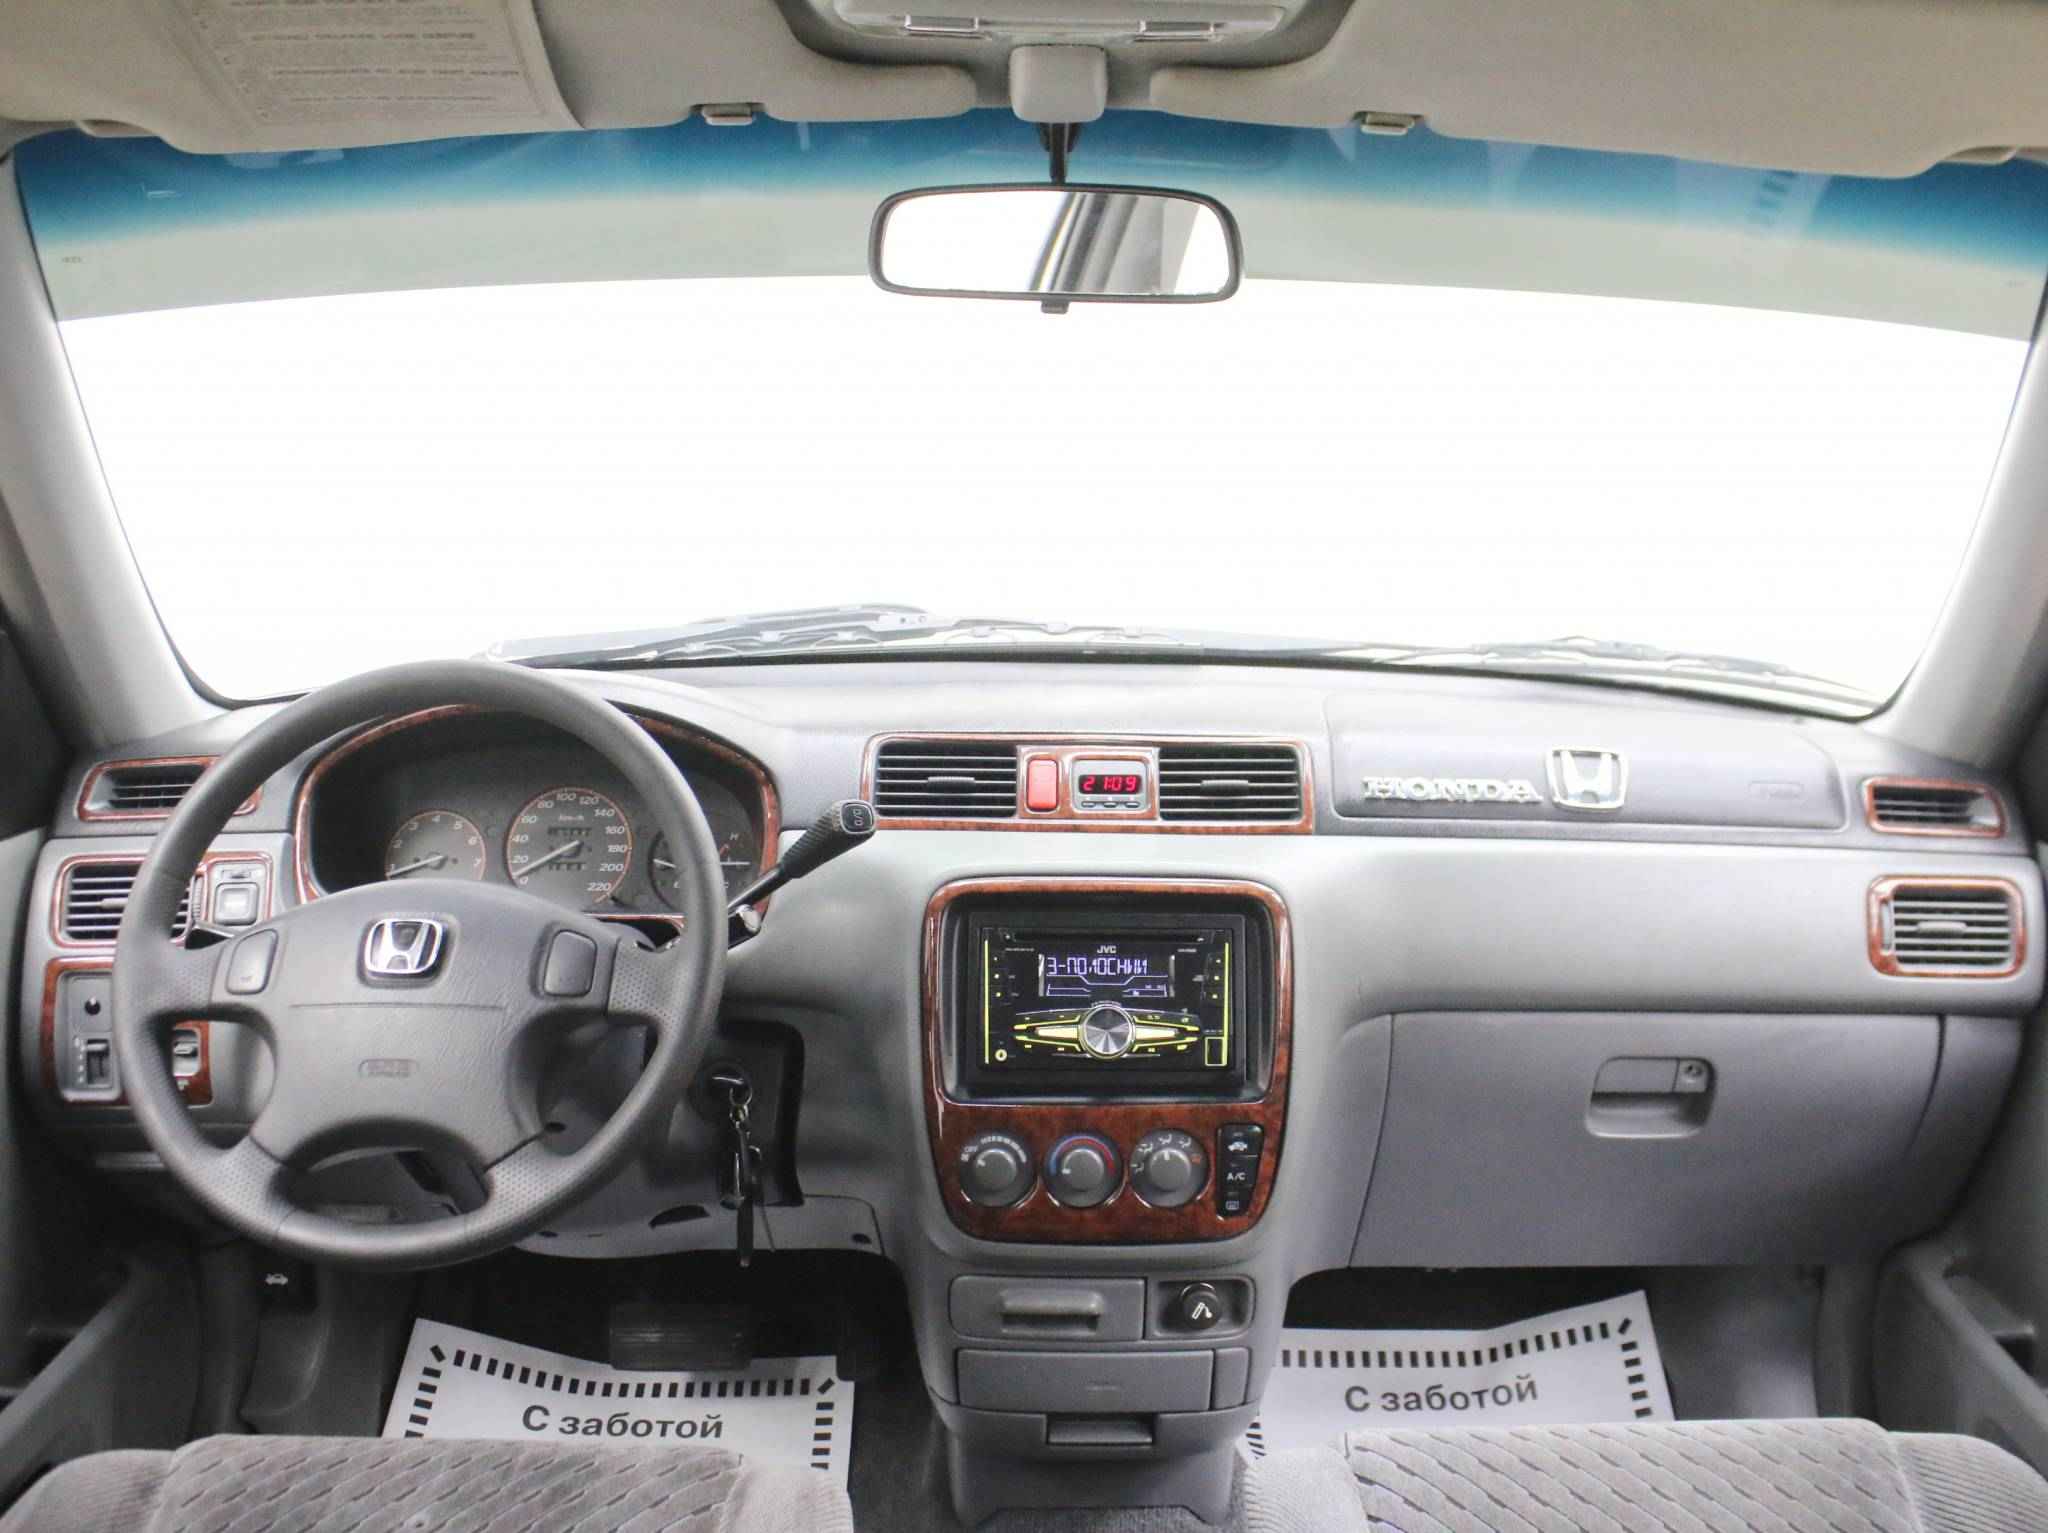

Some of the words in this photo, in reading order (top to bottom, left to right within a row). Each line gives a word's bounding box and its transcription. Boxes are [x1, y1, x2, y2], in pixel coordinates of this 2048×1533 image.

[1082, 775, 1137, 791] 21:09
[1361, 776, 1543, 804] HONDA
[556, 793, 576, 801] 100
[579, 796, 599, 805] 120
[537, 800, 554, 809] 80
[594, 808, 615, 817] 140
[521, 815, 537, 824] 60
[605, 826, 625, 834] 160
[512, 834, 529, 842] 40
[608, 844, 628, 853] 180
[512, 855, 528, 864] 20
[599, 863, 624, 872] 200
[587, 882, 611, 892] 220
[1096, 945, 1117, 954] JVC
[1226, 1172, 1246, 1181] A/C
[1344, 1385, 1370, 1413] С
[1380, 1374, 1538, 1412] заботой
[521, 1404, 550, 1432] С
[558, 1413, 724, 1440] заботой
